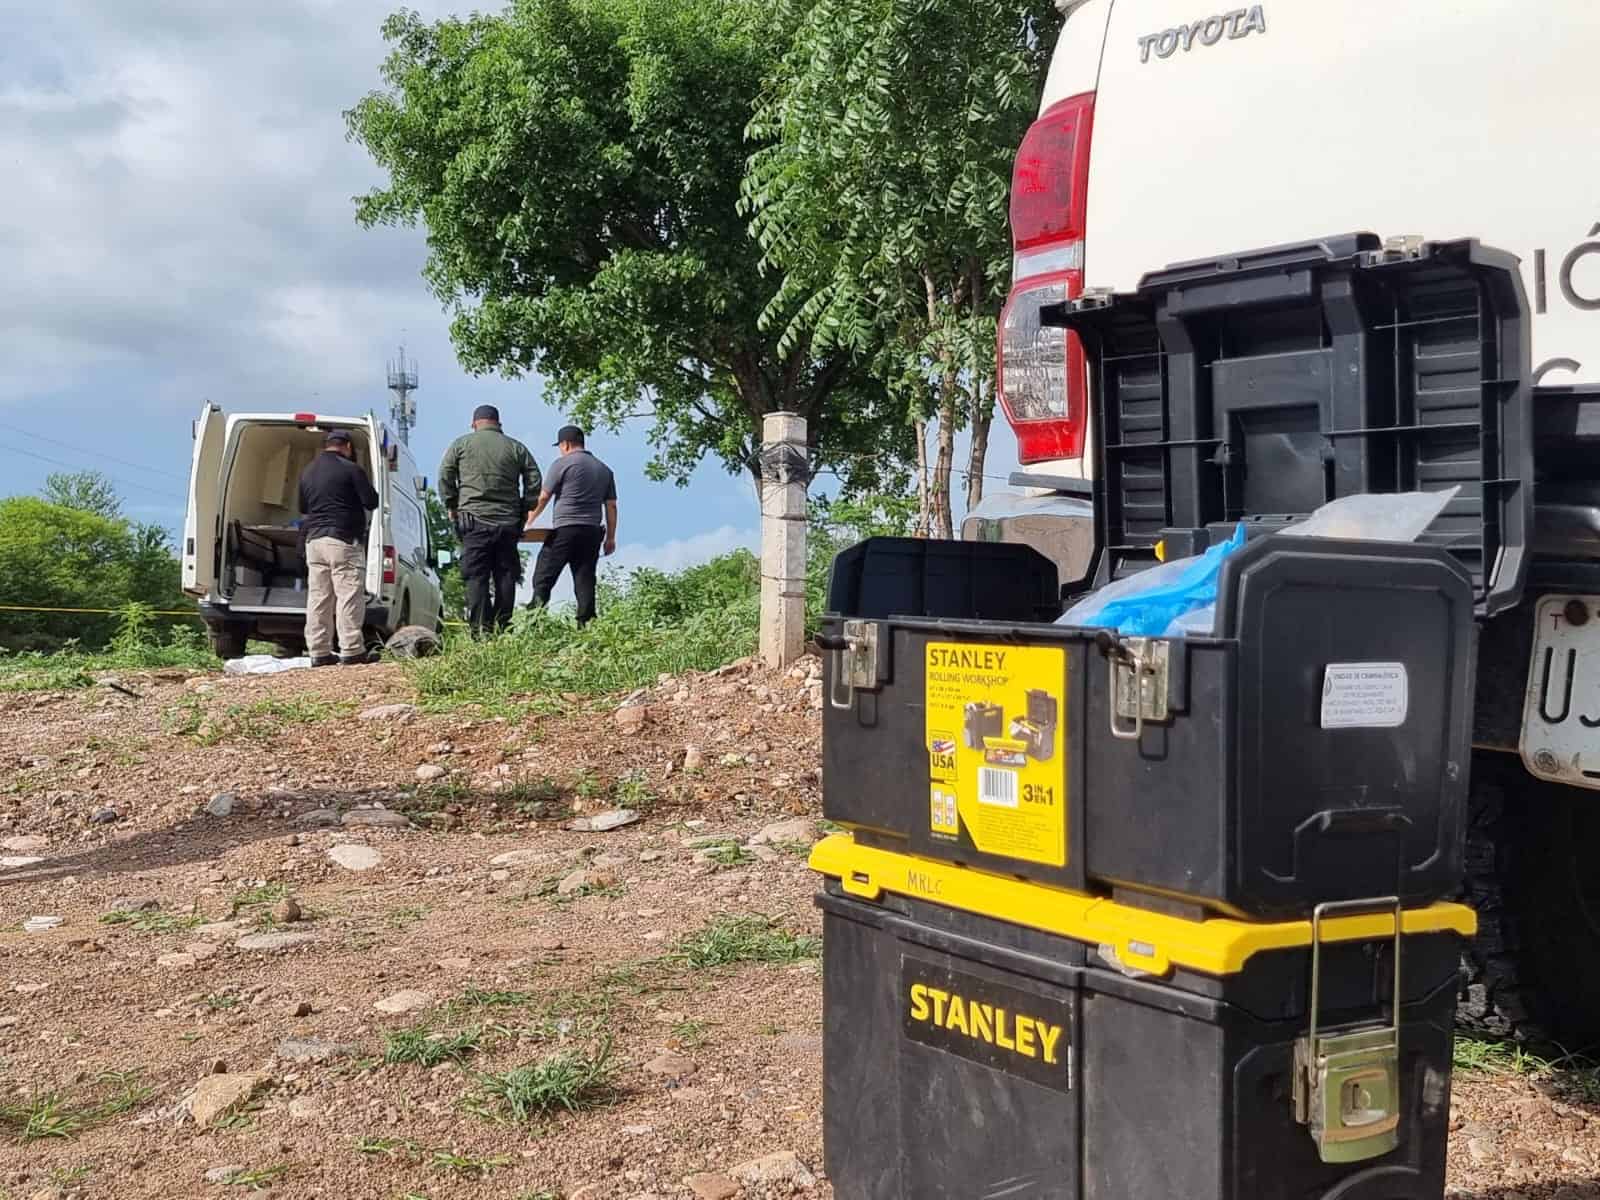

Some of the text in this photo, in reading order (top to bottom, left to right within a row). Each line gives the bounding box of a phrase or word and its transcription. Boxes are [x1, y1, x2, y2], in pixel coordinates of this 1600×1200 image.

[1138, 4, 1266, 64] TOYOTA
[930, 648, 1006, 671] STANLEY
[929, 671, 961, 682] ROLLING
[932, 754, 954, 769] USA
[1023, 784, 1033, 802] 3
[1046, 788, 1054, 806] 1
[910, 983, 1062, 1064] STANLEY
